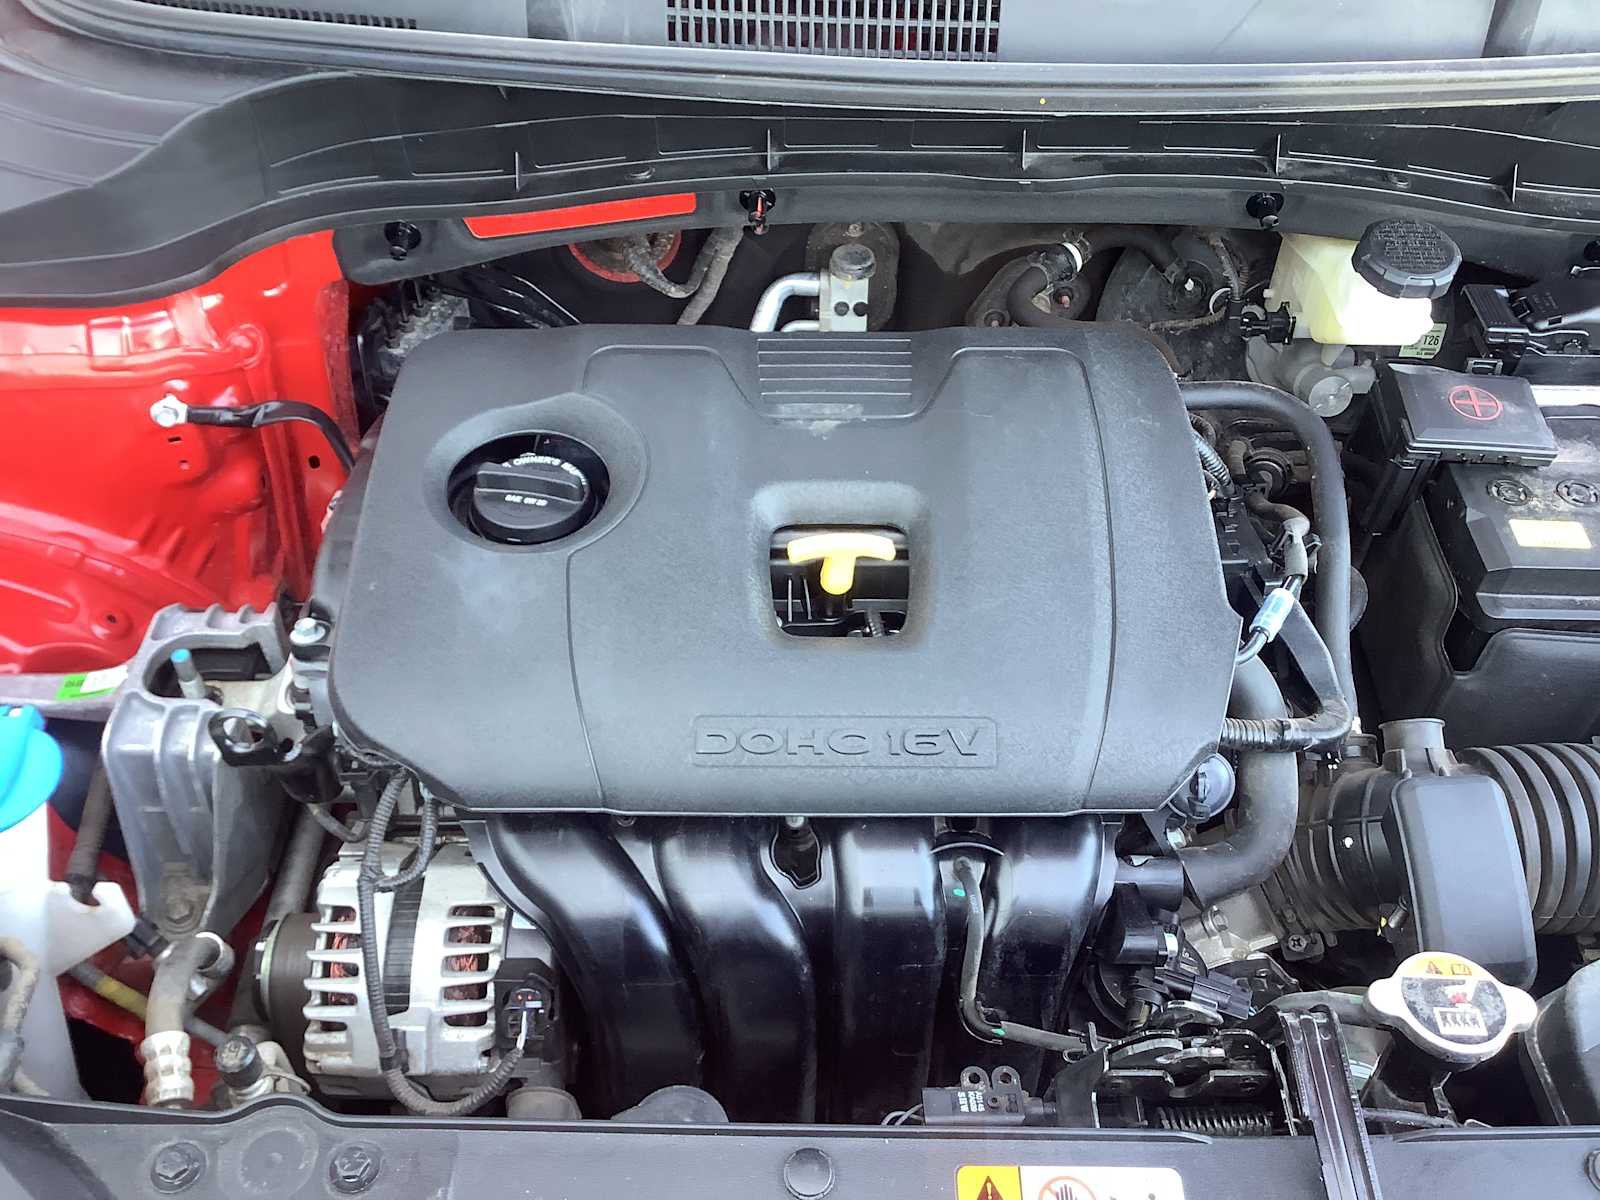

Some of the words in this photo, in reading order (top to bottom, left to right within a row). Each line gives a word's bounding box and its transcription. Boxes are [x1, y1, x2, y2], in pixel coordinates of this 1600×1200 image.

[513, 456, 561, 466] OWNER'S
[695, 727, 870, 756] DOHC
[886, 727, 984, 756] 16V
